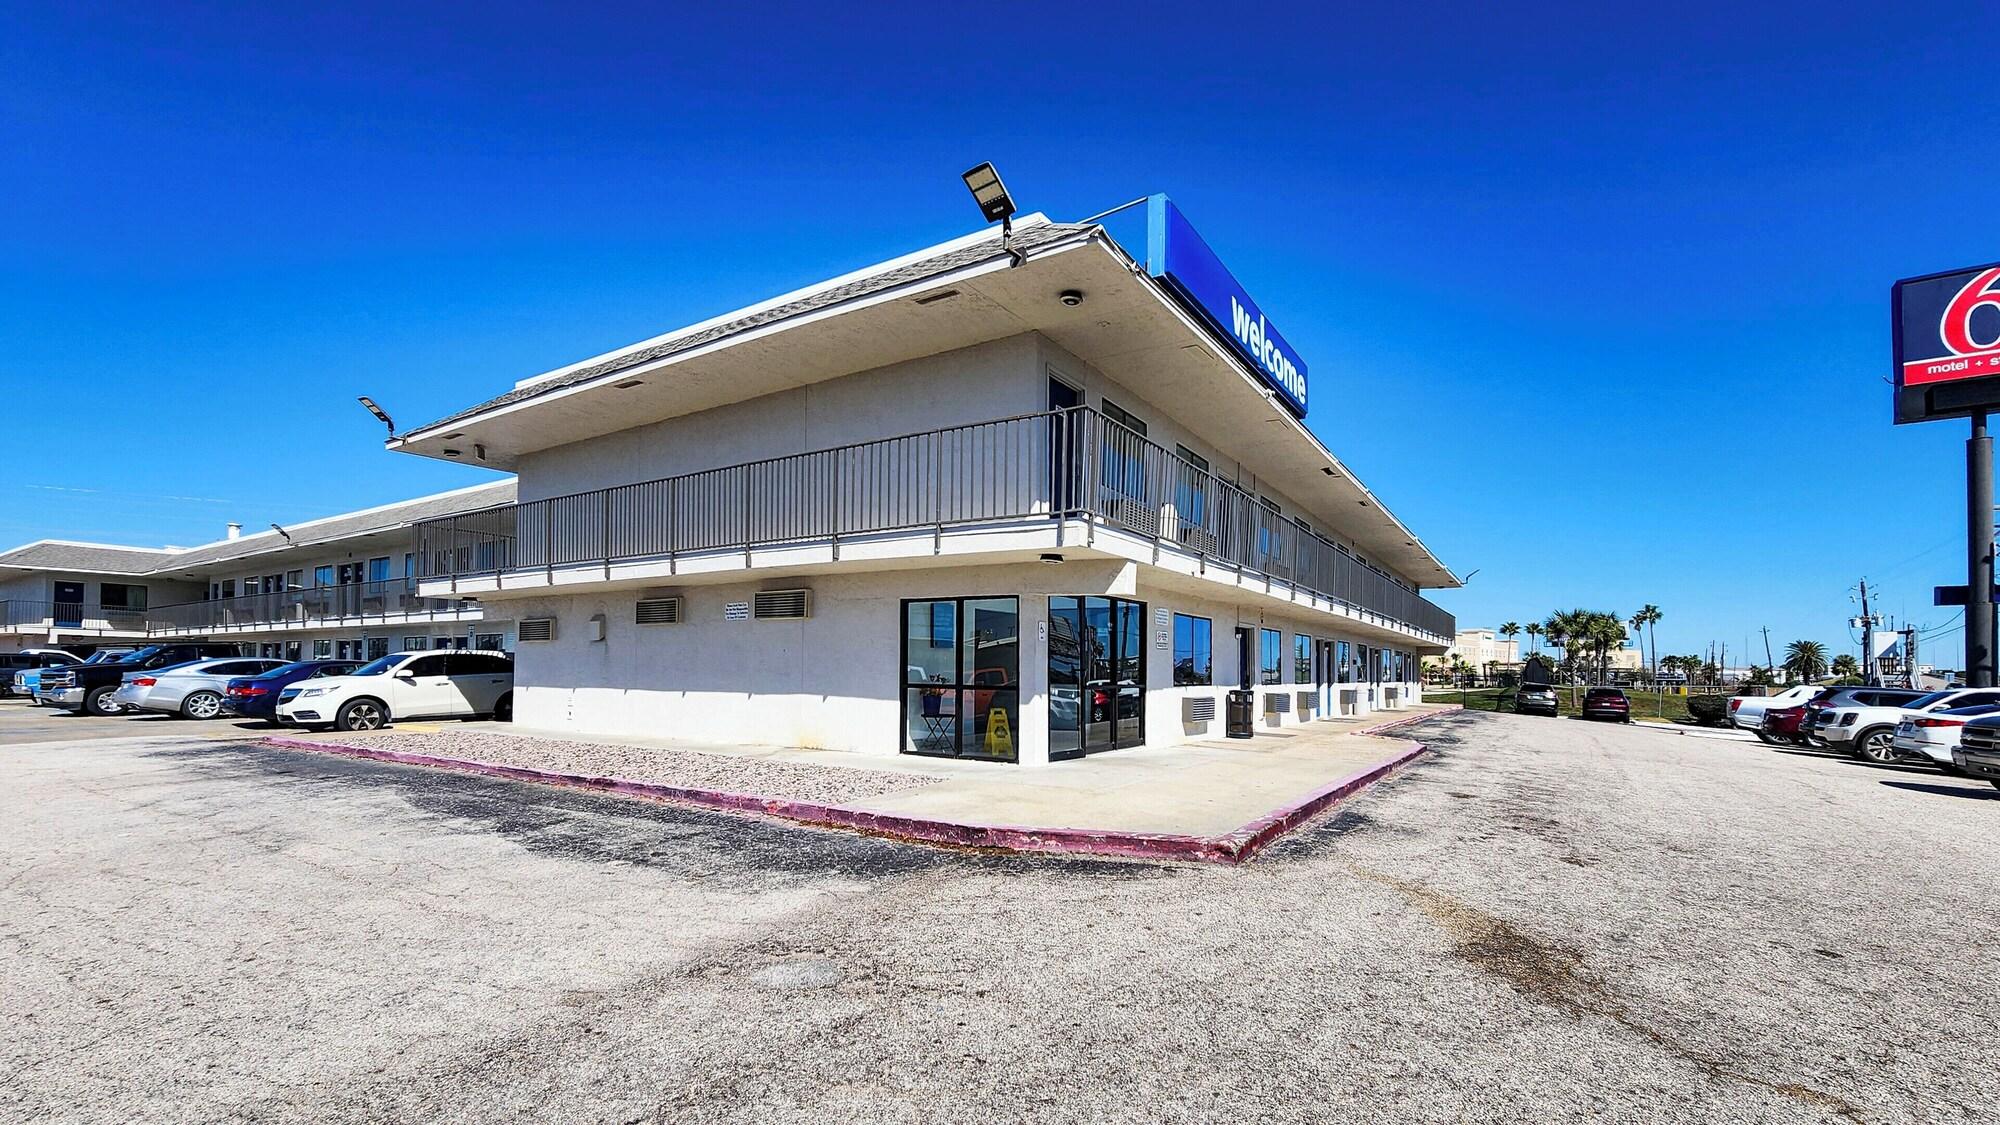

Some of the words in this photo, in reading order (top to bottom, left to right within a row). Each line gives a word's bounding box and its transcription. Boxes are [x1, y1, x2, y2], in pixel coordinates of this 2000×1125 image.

[1231, 295, 1306, 405] welcome
[1940, 267, 2000, 356] 6
[1928, 360, 1968, 374] motel
